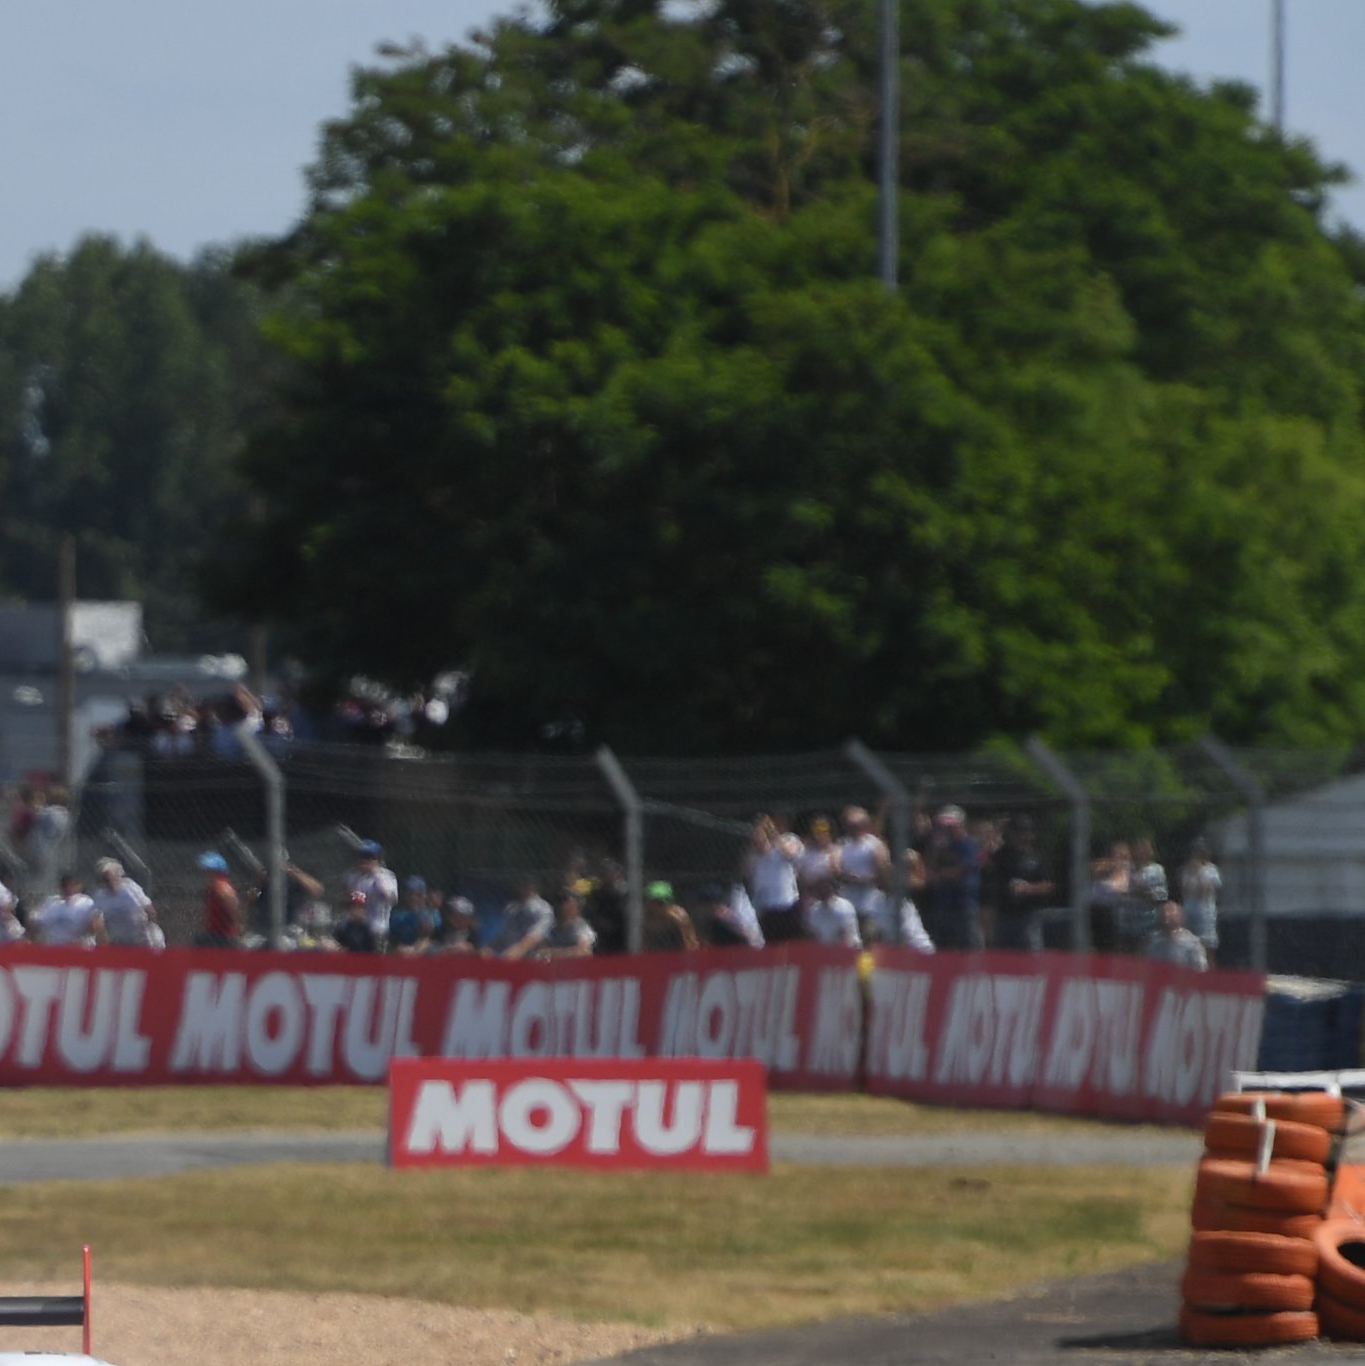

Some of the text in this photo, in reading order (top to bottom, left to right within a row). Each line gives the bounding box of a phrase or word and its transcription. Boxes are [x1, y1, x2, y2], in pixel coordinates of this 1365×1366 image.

[172, 970, 421, 1077] MOTUL
[443, 977, 646, 1058] MOTUL
[659, 966, 801, 1071] MOTUL
[406, 1078, 755, 1155] MOTUL
